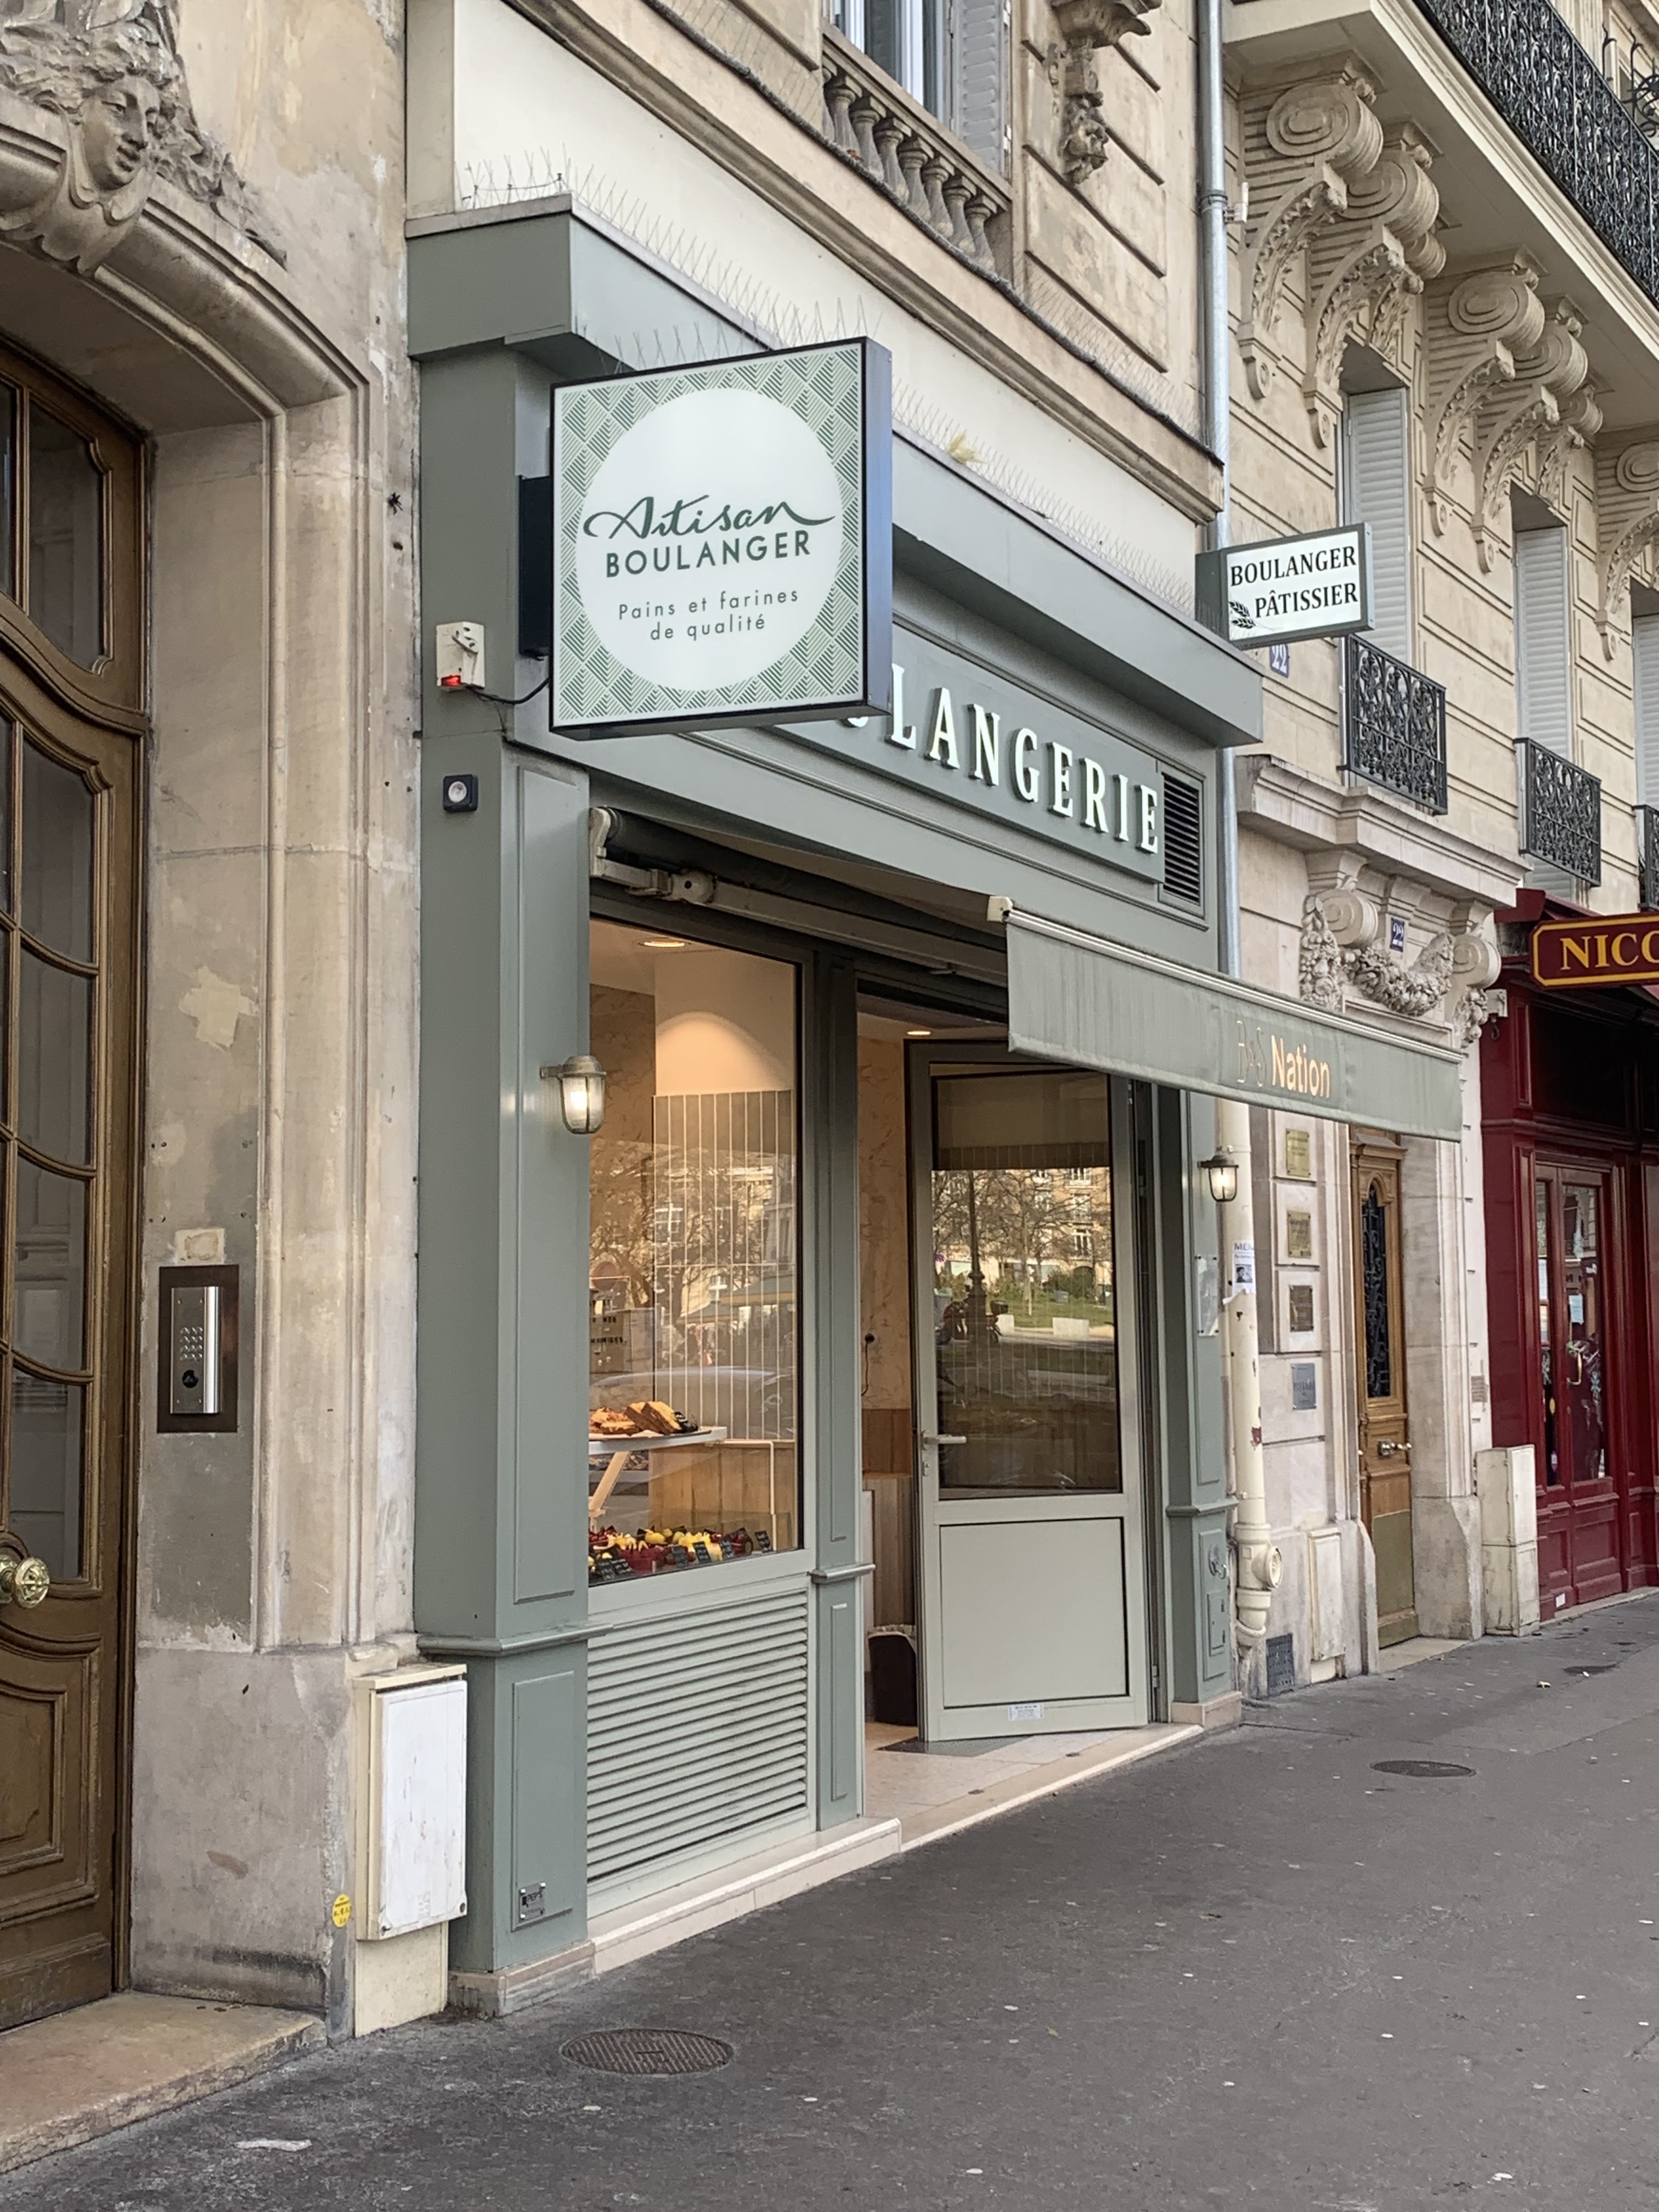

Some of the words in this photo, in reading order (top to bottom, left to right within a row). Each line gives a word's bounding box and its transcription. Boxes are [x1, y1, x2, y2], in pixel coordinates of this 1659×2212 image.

[583, 495, 836, 539] Artisan
[606, 530, 810, 578] BOULANGER
[1230, 546, 1357, 586] BOULANGER
[619, 601, 675, 620] Pains
[689, 598, 707, 613] et
[720, 589, 798, 609] farines
[1255, 583, 1358, 618] PÂTISSIER
[650, 622, 674, 640] de
[687, 614, 765, 640] qualité
[848, 663, 1158, 854] LANGERIE
[1271, 1035, 1330, 1098] Nation
